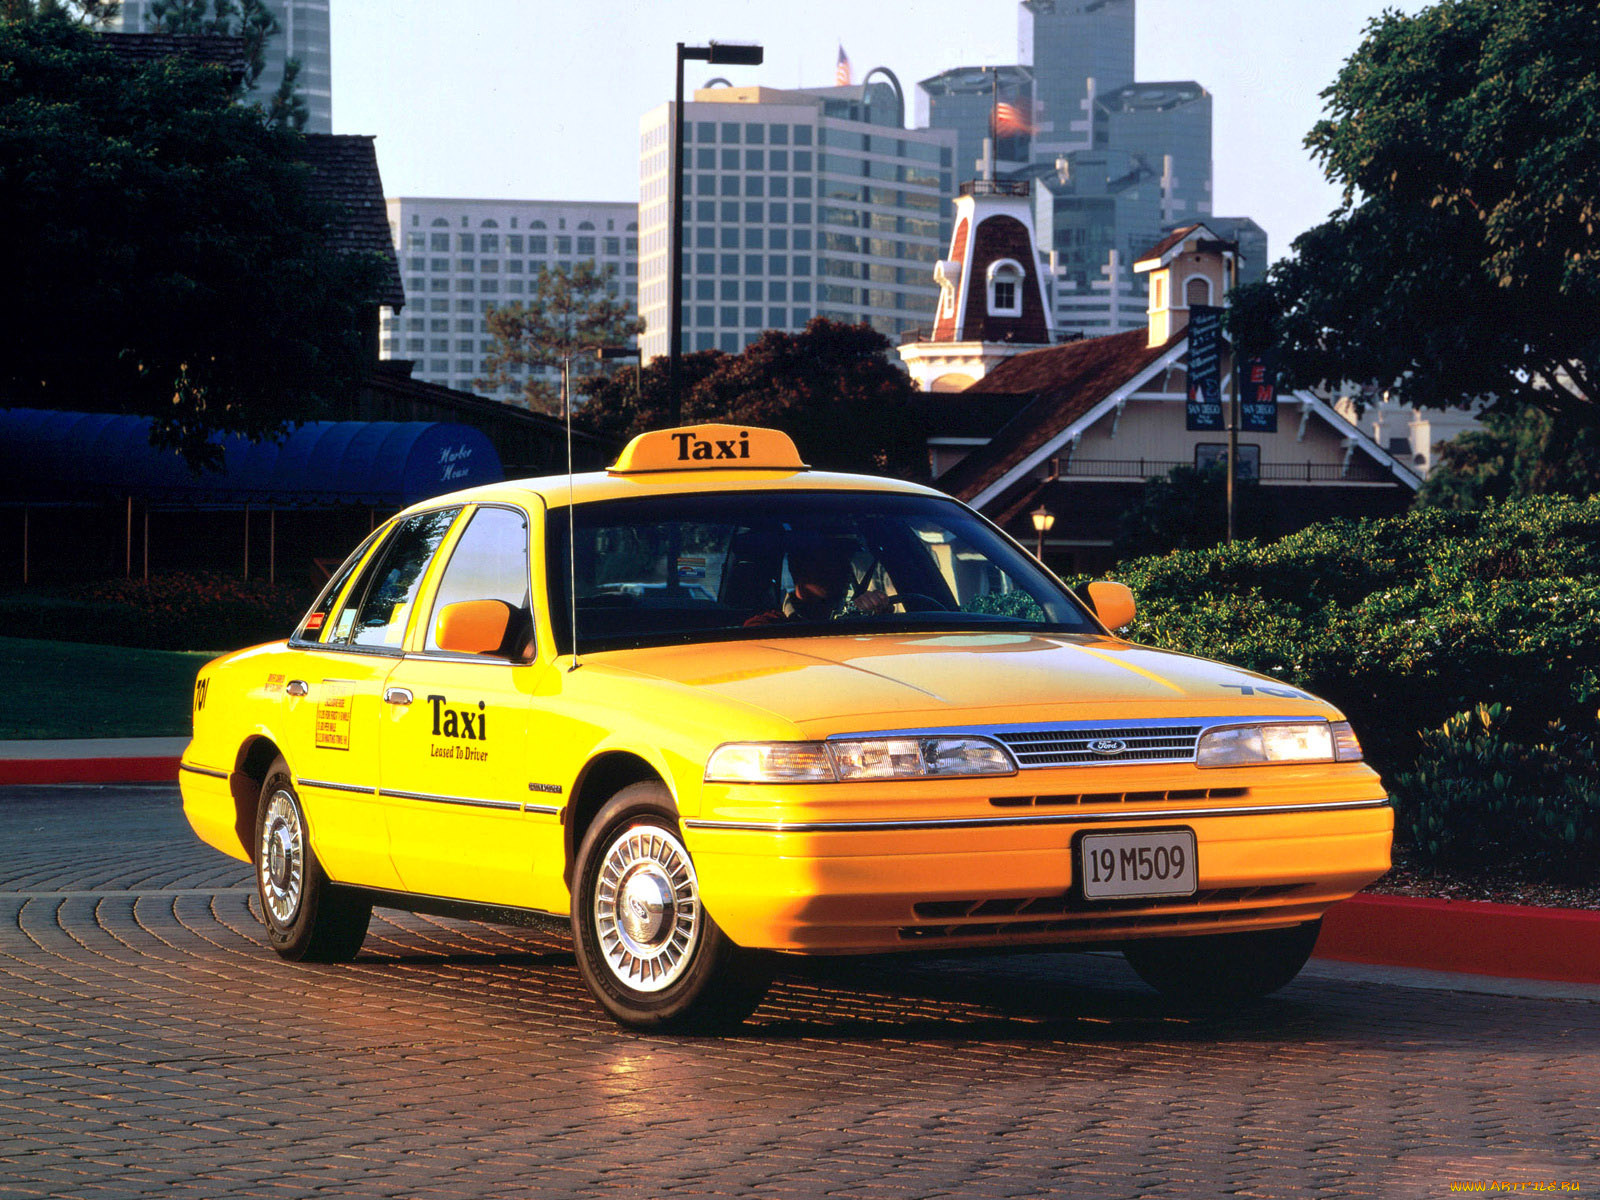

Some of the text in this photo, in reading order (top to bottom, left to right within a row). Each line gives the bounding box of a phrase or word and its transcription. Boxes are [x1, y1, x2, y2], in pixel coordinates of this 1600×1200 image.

[671, 431, 750, 460] Taxi
[427, 694, 487, 741] Taxi
[430, 743, 488, 762] Leased To Driver
